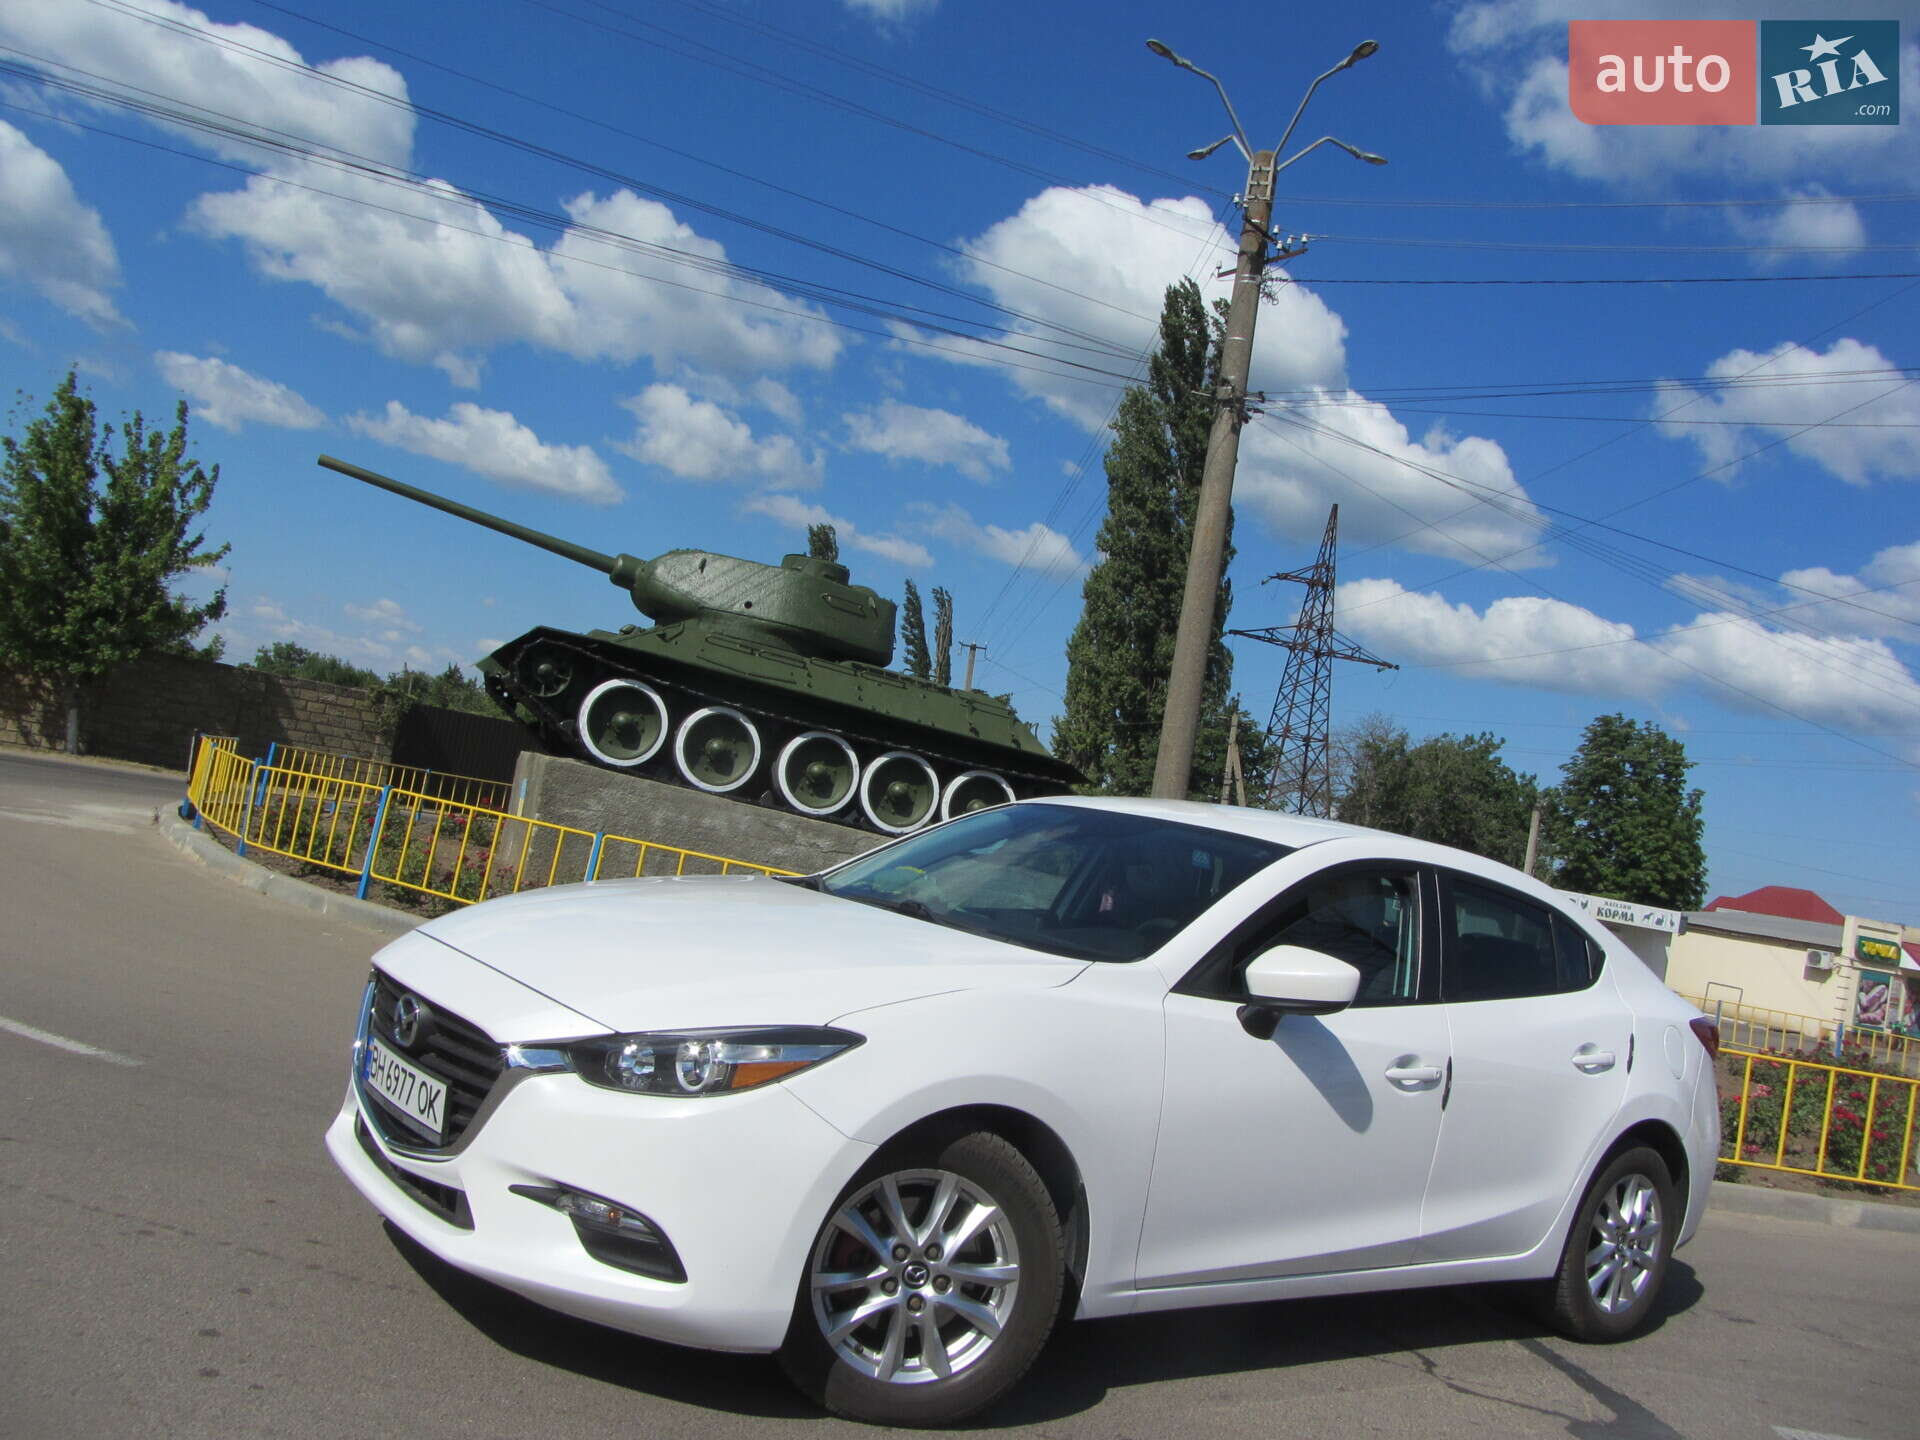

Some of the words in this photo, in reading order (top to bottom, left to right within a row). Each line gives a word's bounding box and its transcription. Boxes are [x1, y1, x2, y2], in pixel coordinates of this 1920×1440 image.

[1596, 907, 1634, 922] КОРМА
[370, 1045, 386, 1086] BH
[386, 1059, 416, 1106] 6977
[417, 1080, 441, 1123] OK
